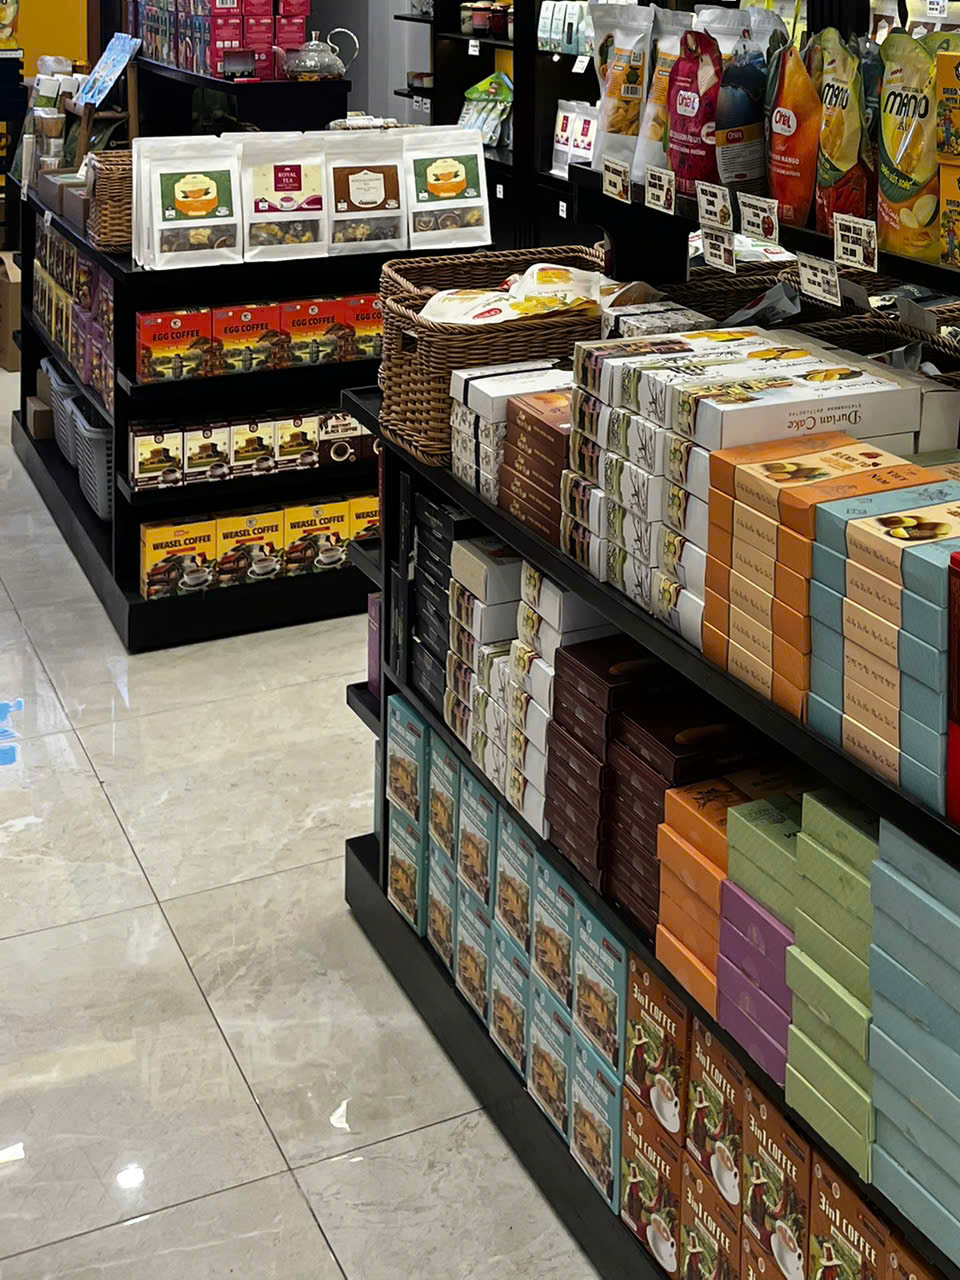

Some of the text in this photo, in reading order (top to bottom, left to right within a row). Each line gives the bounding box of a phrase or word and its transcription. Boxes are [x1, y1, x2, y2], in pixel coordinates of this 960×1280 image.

[292, 316, 336, 327] EGG COFFEE
[356, 313, 369, 321] EGG
[153, 329, 201, 342] EGG COFFEE
[224, 322, 270, 334] EGG COFFEE
[787, 410, 862, 431] Durian Cake
[290, 514, 345, 531] WEASEL COFFEE
[355, 510, 379, 520] WEASE
[222, 524, 279, 541] WEASEL COFFEE
[153, 535, 212, 551] WEASEL COFFEE
[632, 983, 677, 1038] 3in1 COFFEE
[626, 1122, 671, 1180] 3in1 COFFEE
[749, 1114, 798, 1182] 3in1 COFFEE
[819, 1191, 878, 1268] 3in1 COFFEE
